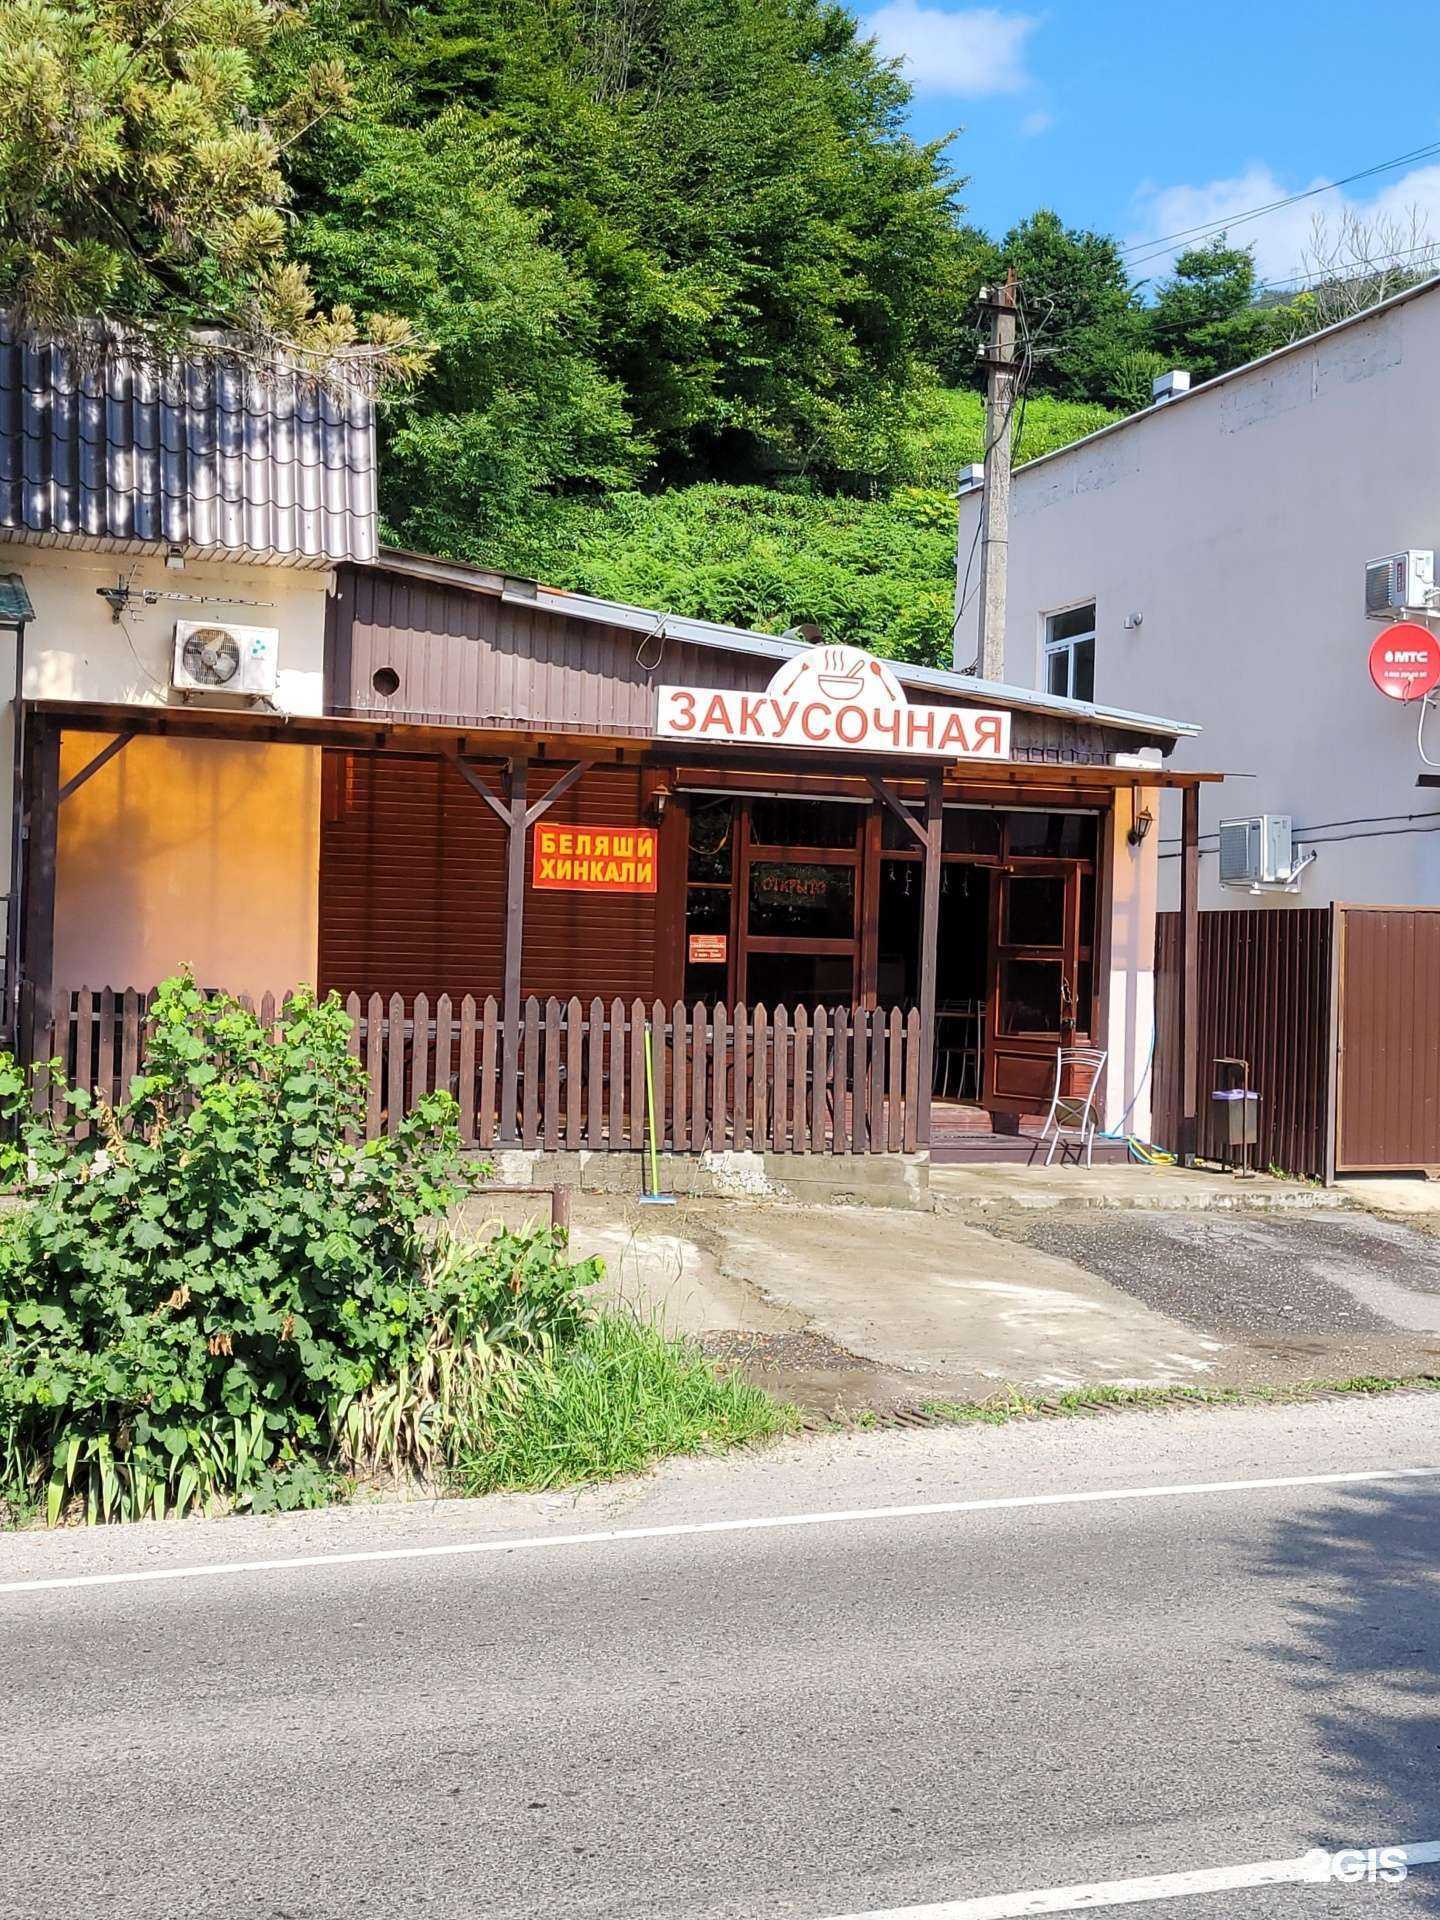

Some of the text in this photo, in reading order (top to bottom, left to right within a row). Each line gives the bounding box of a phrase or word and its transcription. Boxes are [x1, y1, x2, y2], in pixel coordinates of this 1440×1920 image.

[1394, 651, 1428, 663] МТС
[669, 691, 1002, 754] ЗАКУСОЧНАЯ
[541, 832, 653, 858] БЕЛЯШИ
[539, 858, 652, 884] ХИНКАЛИ
